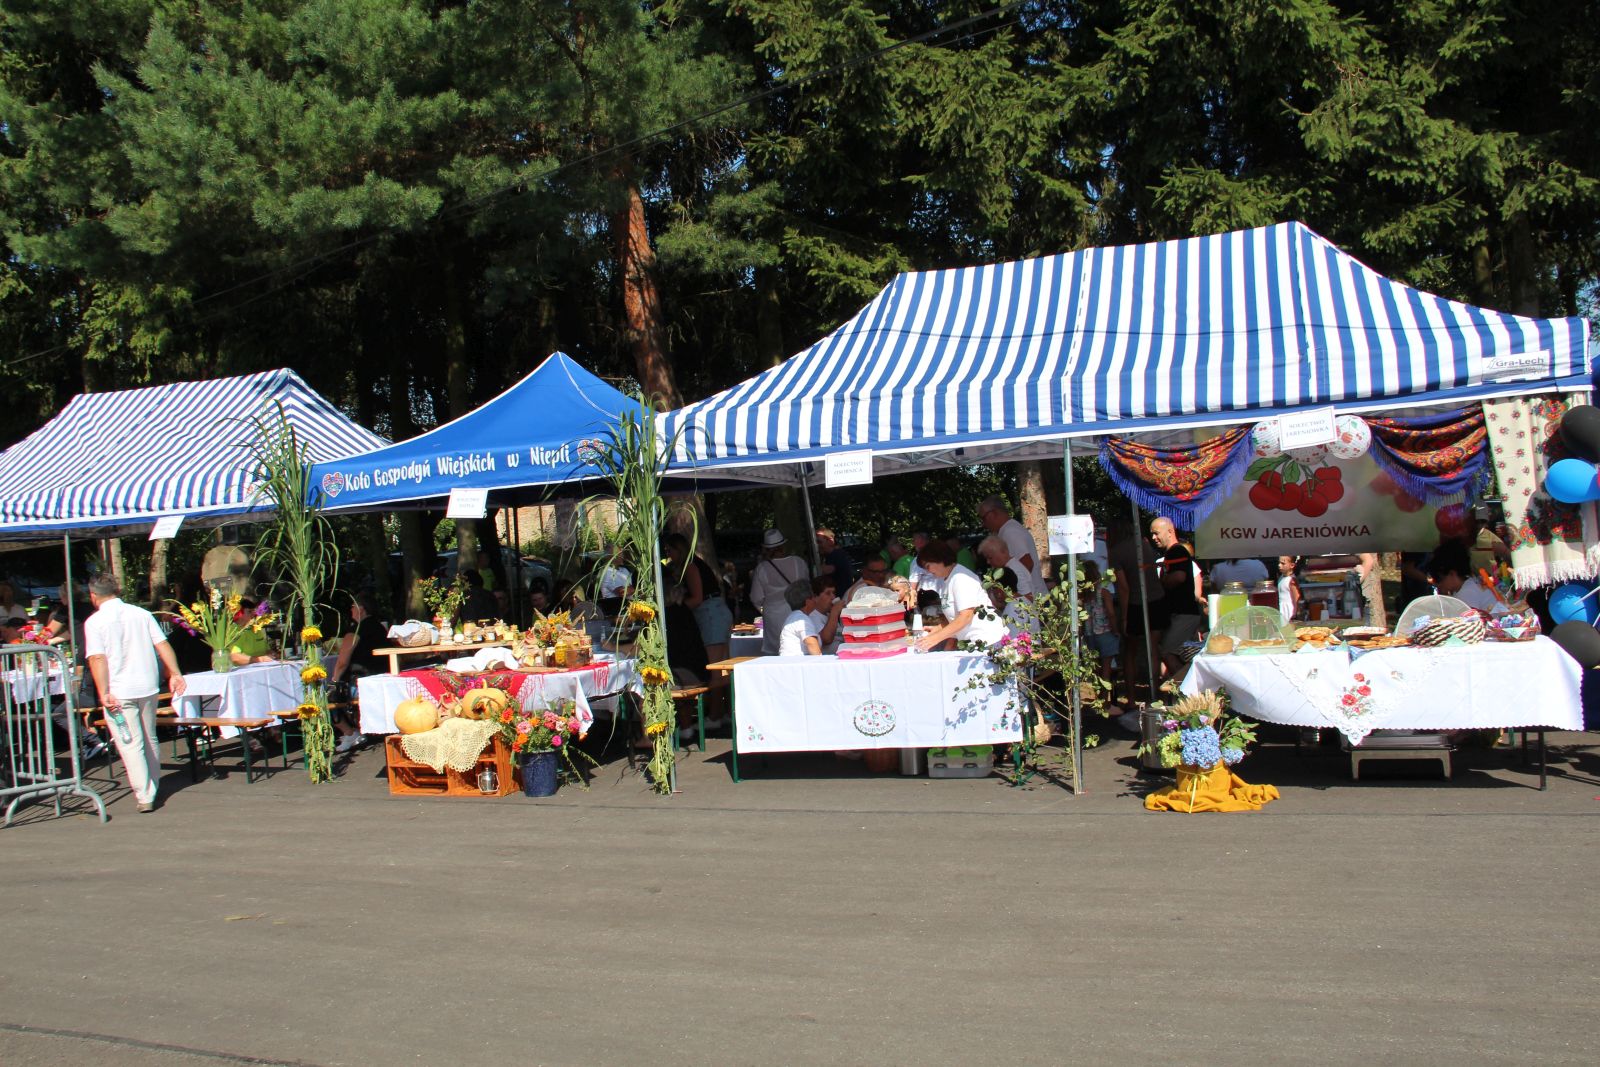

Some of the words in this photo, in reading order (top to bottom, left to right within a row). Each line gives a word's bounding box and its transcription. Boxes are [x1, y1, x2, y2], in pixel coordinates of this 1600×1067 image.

[1496, 357, 1544, 367] Gra-Lech
[345, 472, 371, 492] Koło
[374, 459, 431, 486] Gospodyń
[437, 452, 496, 477] Wiejskich
[507, 453, 520, 468] w
[1220, 527, 1257, 539] KGW
[1261, 523, 1371, 539] JARENIÓWKA
